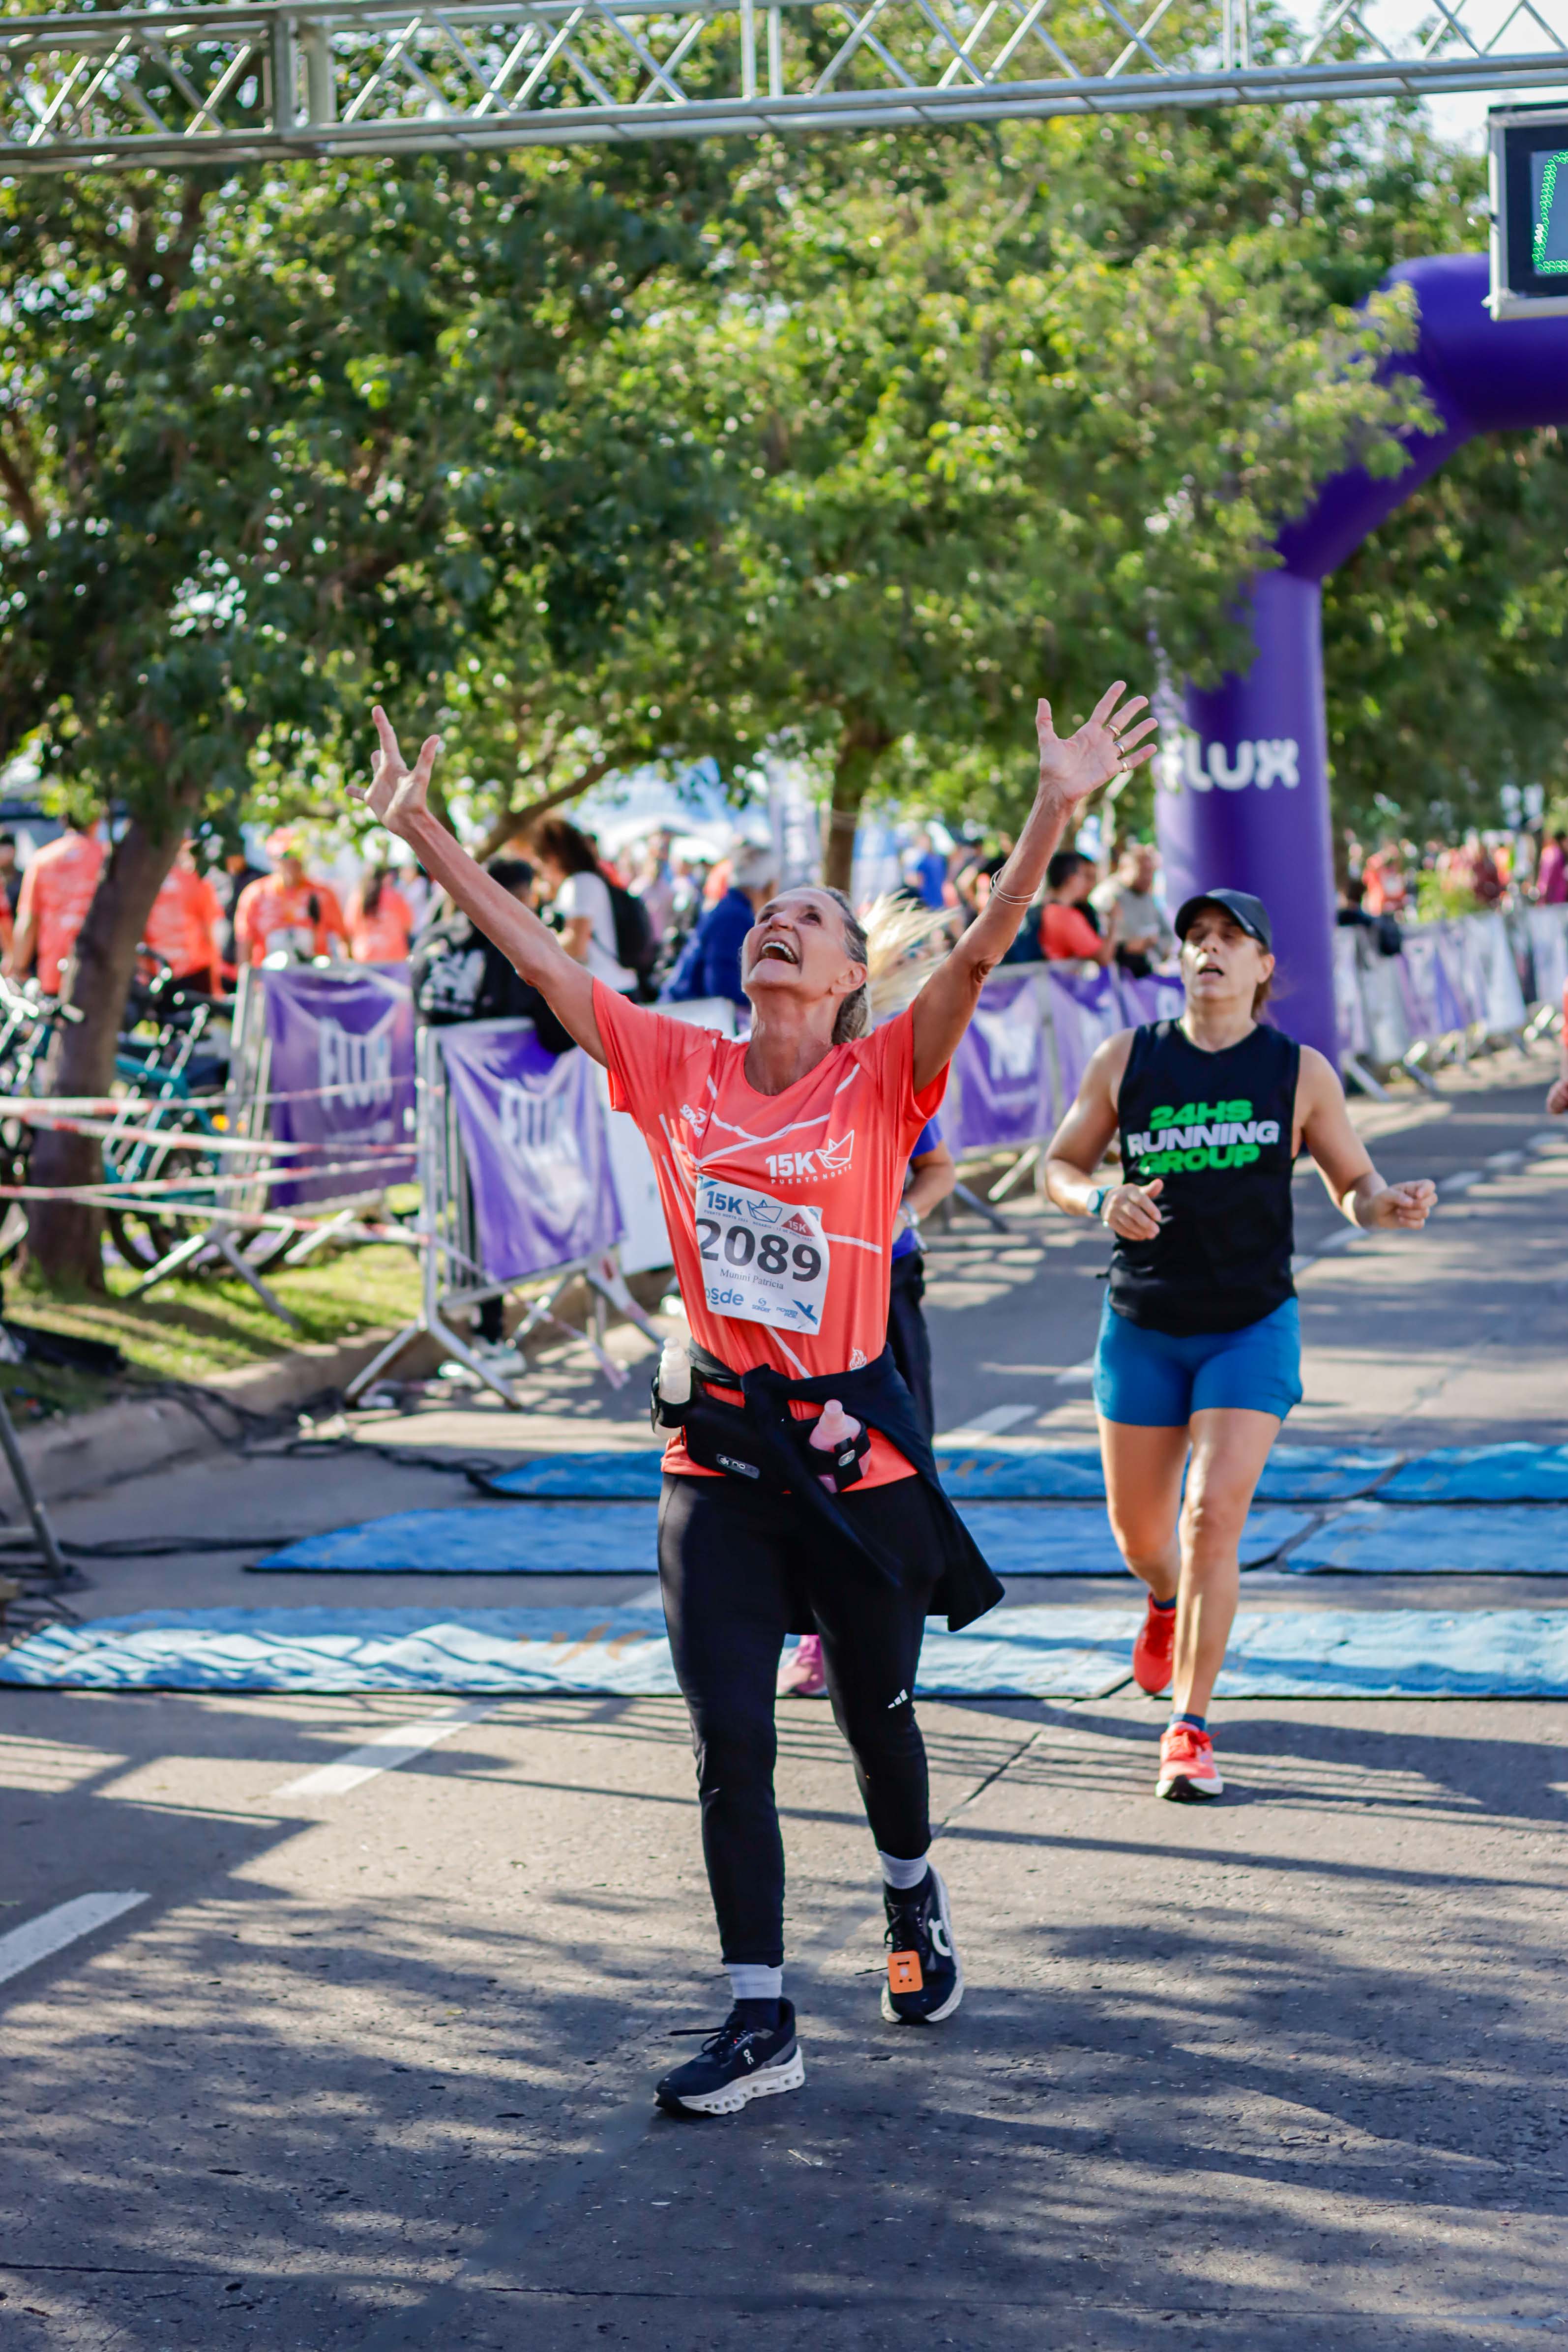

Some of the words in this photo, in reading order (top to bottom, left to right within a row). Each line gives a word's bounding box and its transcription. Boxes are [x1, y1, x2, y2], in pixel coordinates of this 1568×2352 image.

[1149, 1099, 1252, 1130] 24HS
[1127, 1120, 1279, 1157] RUNNING
[765, 1151, 817, 1177] 15K
[1139, 1144, 1260, 1175] GROUP
[771, 1175, 818, 1184] PUERTO
[822, 1163, 852, 1179] NORTE
[707, 1190, 743, 1215] 15K
[788, 1220, 807, 1234] 15K
[696, 1217, 822, 1282] 2089
[720, 1268, 750, 1282] Munini
[753, 1274, 784, 1290] Patricia
